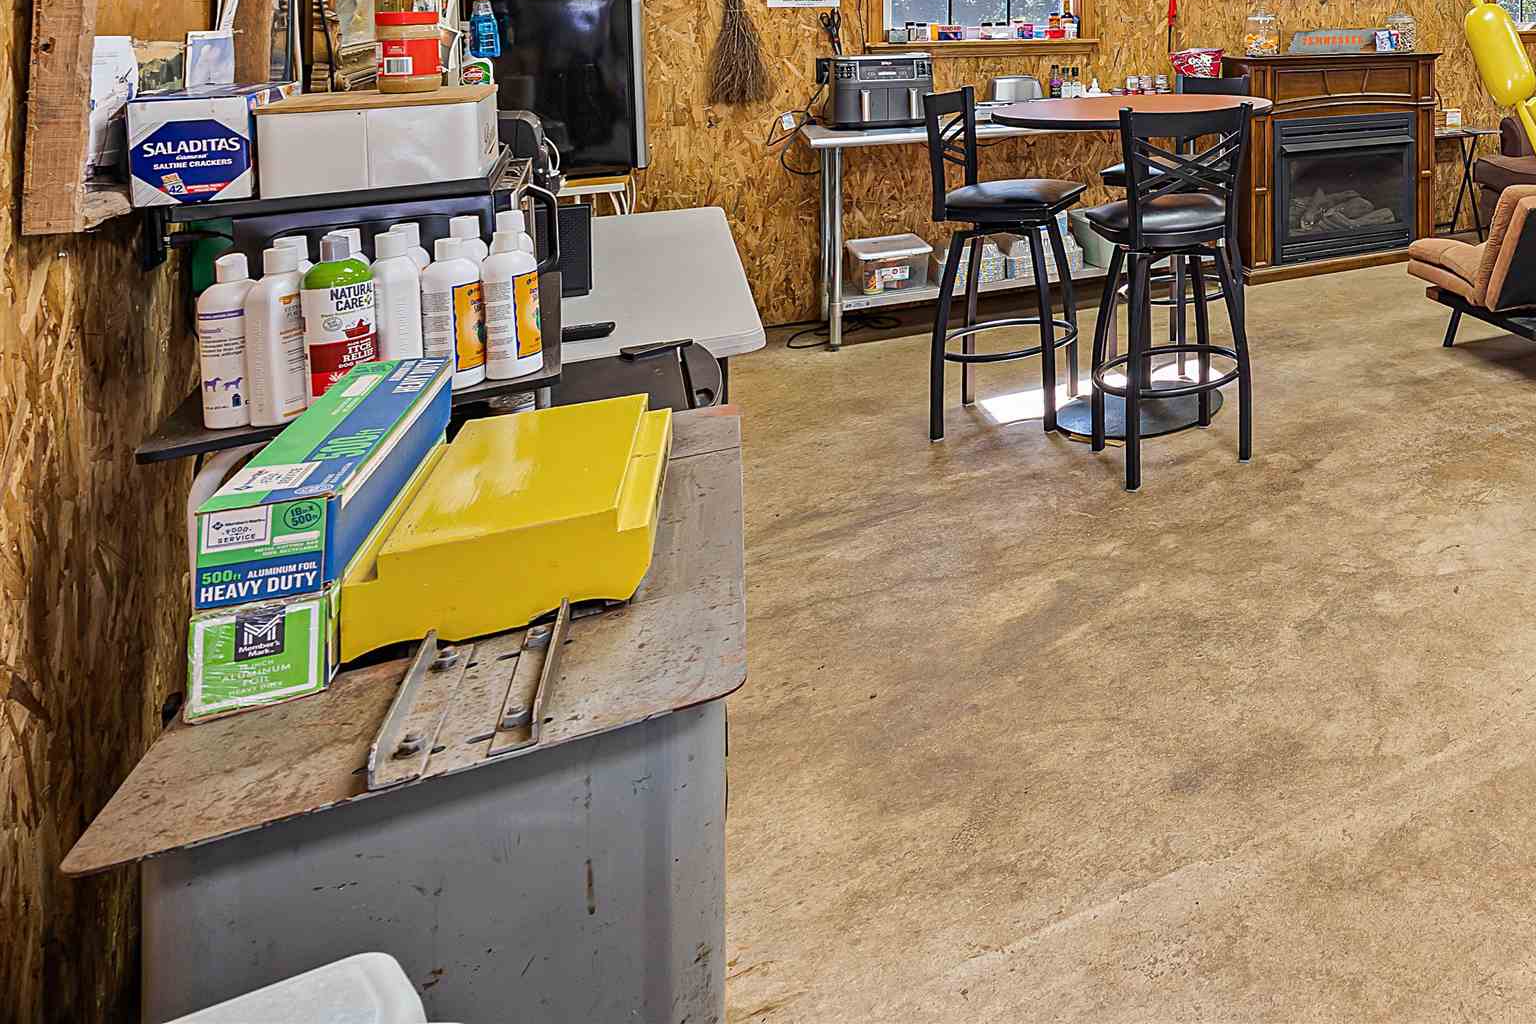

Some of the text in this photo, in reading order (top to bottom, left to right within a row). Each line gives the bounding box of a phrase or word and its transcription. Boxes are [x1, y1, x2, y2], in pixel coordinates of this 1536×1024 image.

[142, 137, 241, 157] SALADITAS
[153, 158, 233, 171] SALTINE CRACKERS
[335, 295, 365, 312] CARE
[247, 563, 297, 579] ALUMINUM
[298, 560, 318, 572] FOIL
[200, 569, 318, 604] HEAVY DUTY
[238, 640, 281, 655] Member's
[248, 648, 269, 658] Mark
